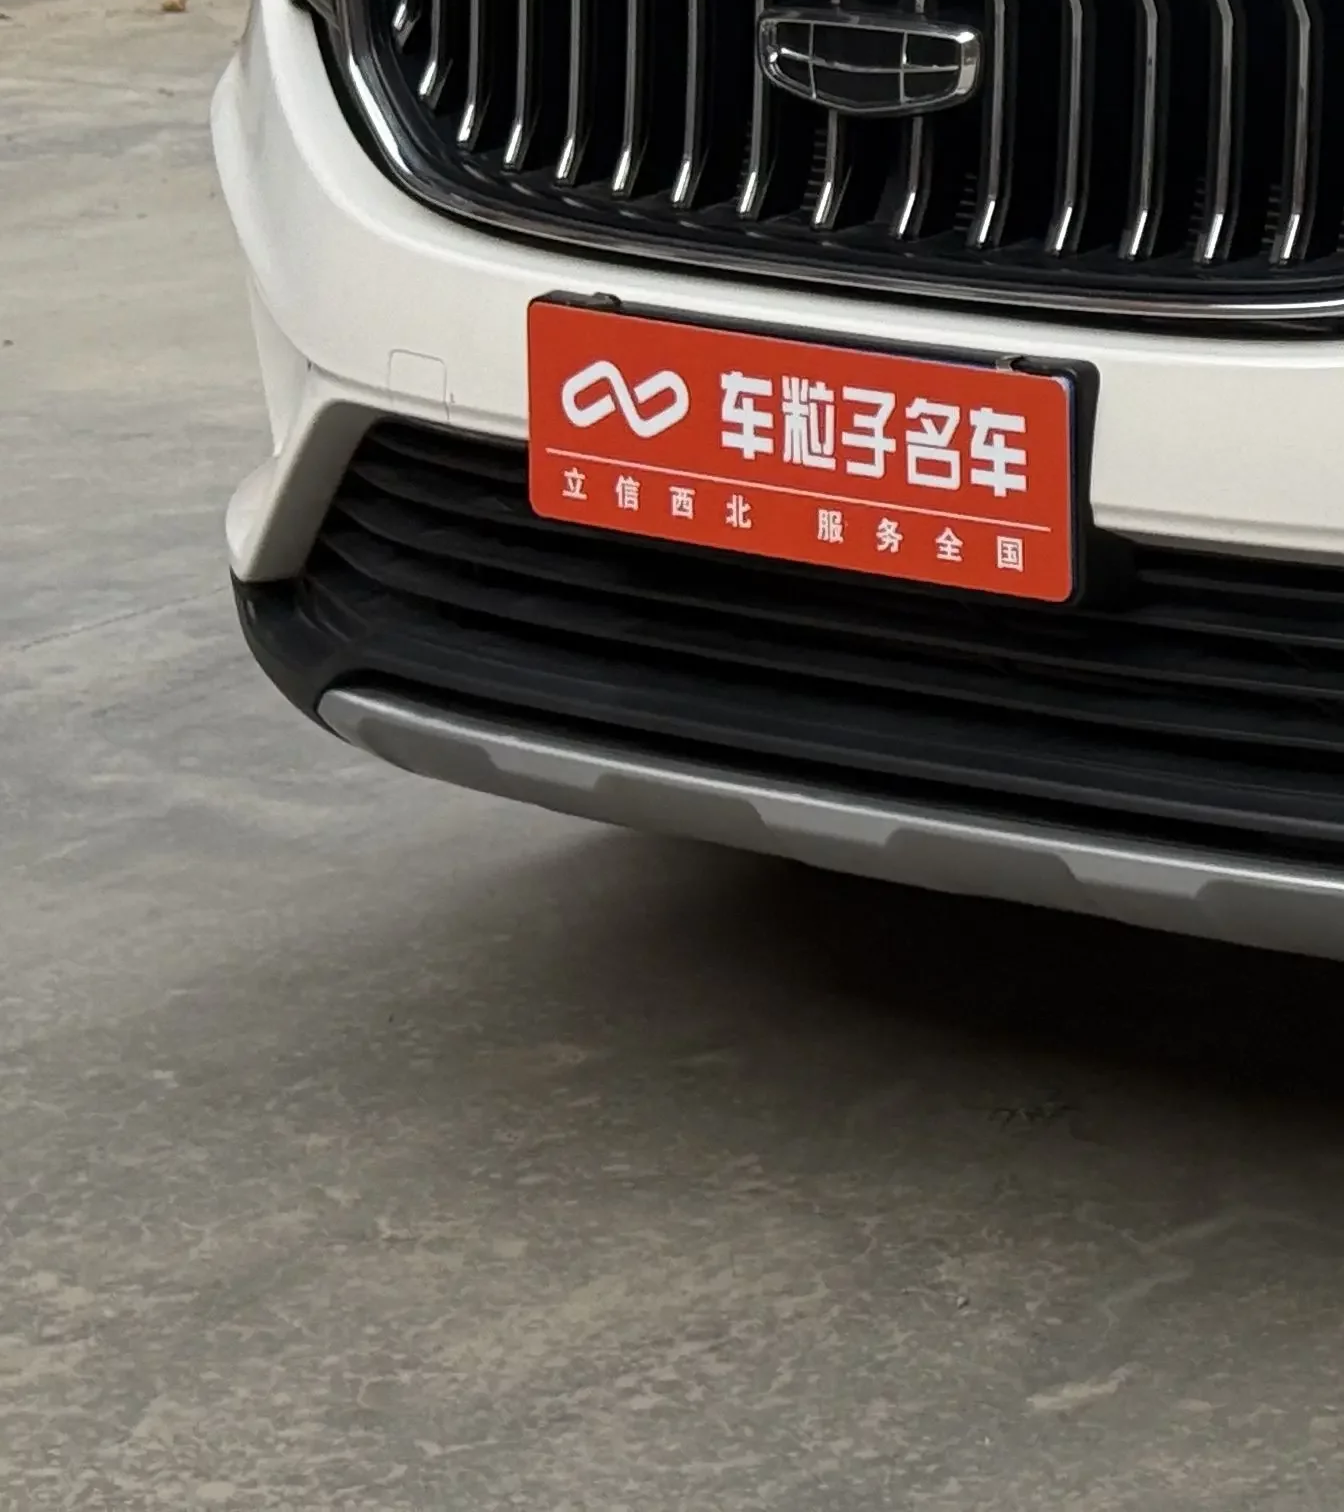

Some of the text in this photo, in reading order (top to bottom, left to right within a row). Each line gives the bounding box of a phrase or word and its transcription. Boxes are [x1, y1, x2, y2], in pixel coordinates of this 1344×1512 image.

[720, 370, 1027, 498] 车粒子名车
[562, 467, 1024, 572] 立信西北 服务全国
